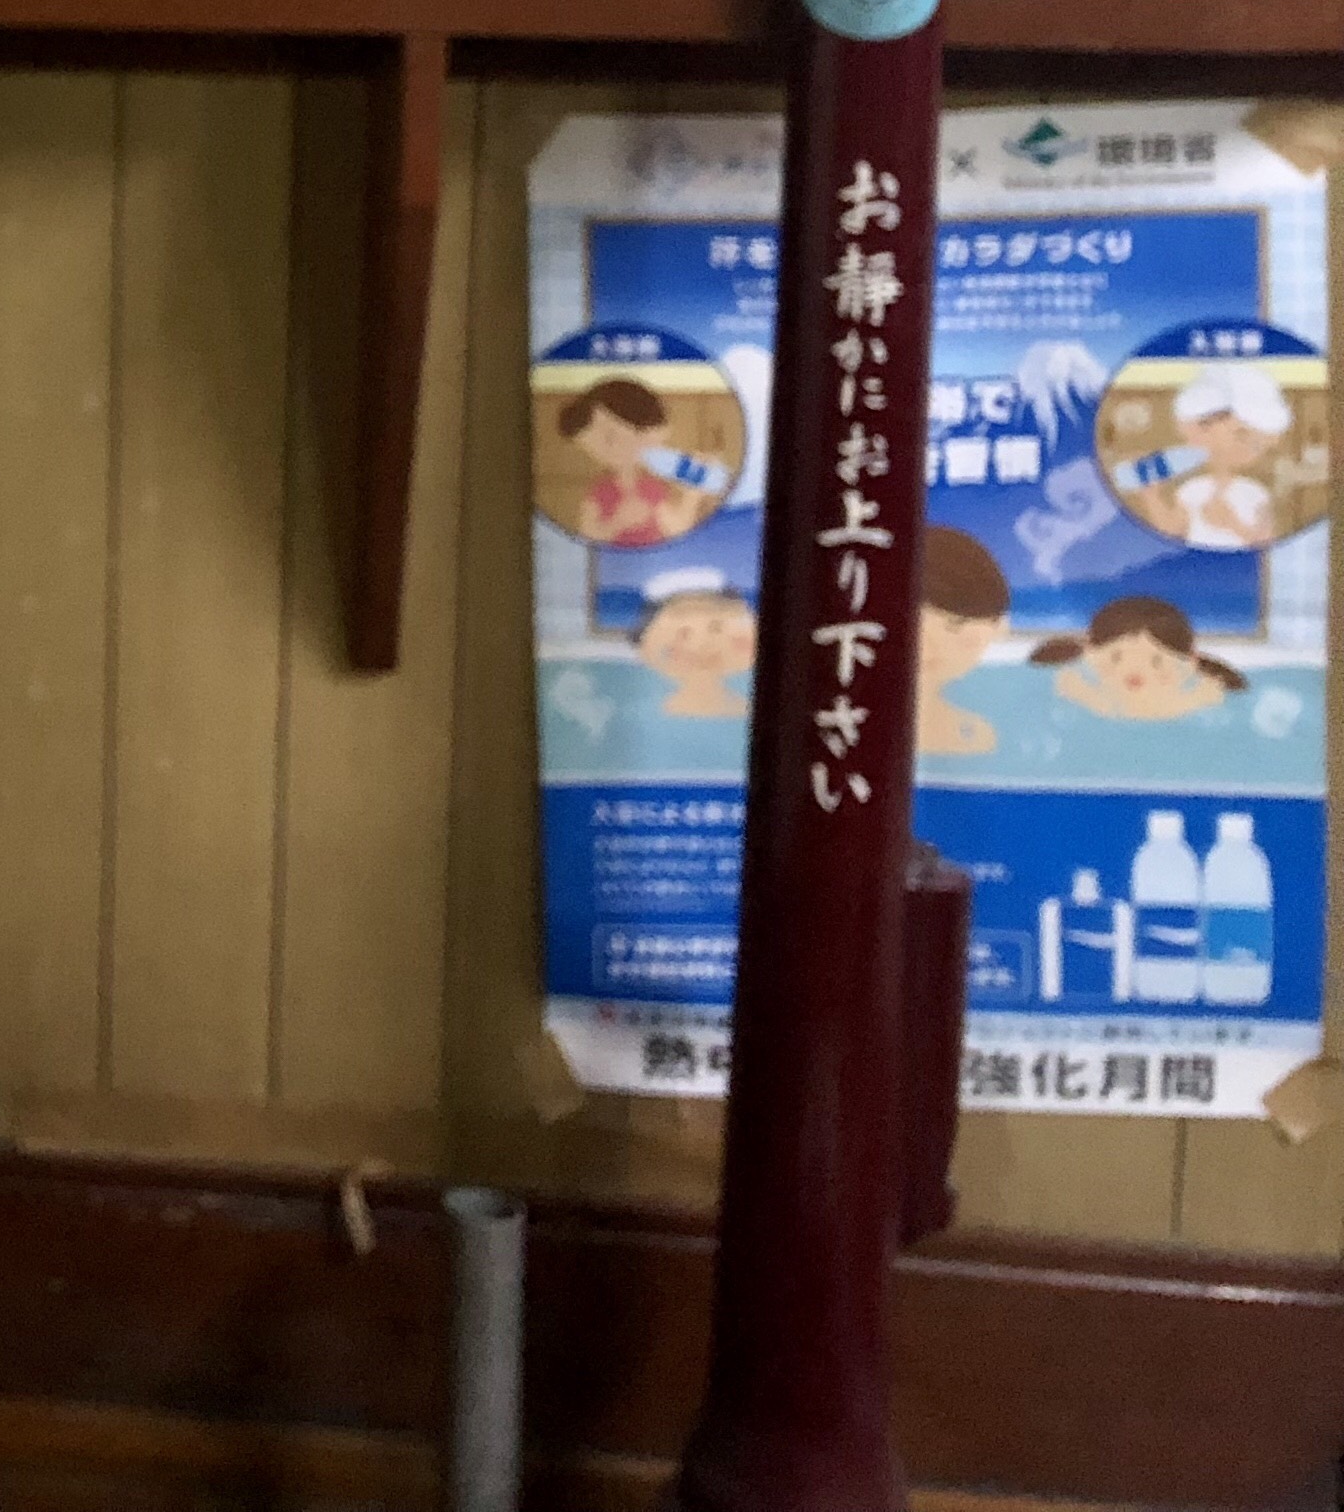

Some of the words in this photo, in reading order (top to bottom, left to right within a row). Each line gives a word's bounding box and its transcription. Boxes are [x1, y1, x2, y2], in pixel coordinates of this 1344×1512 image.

[812, 158, 907, 814] お静かにお上り下さい
